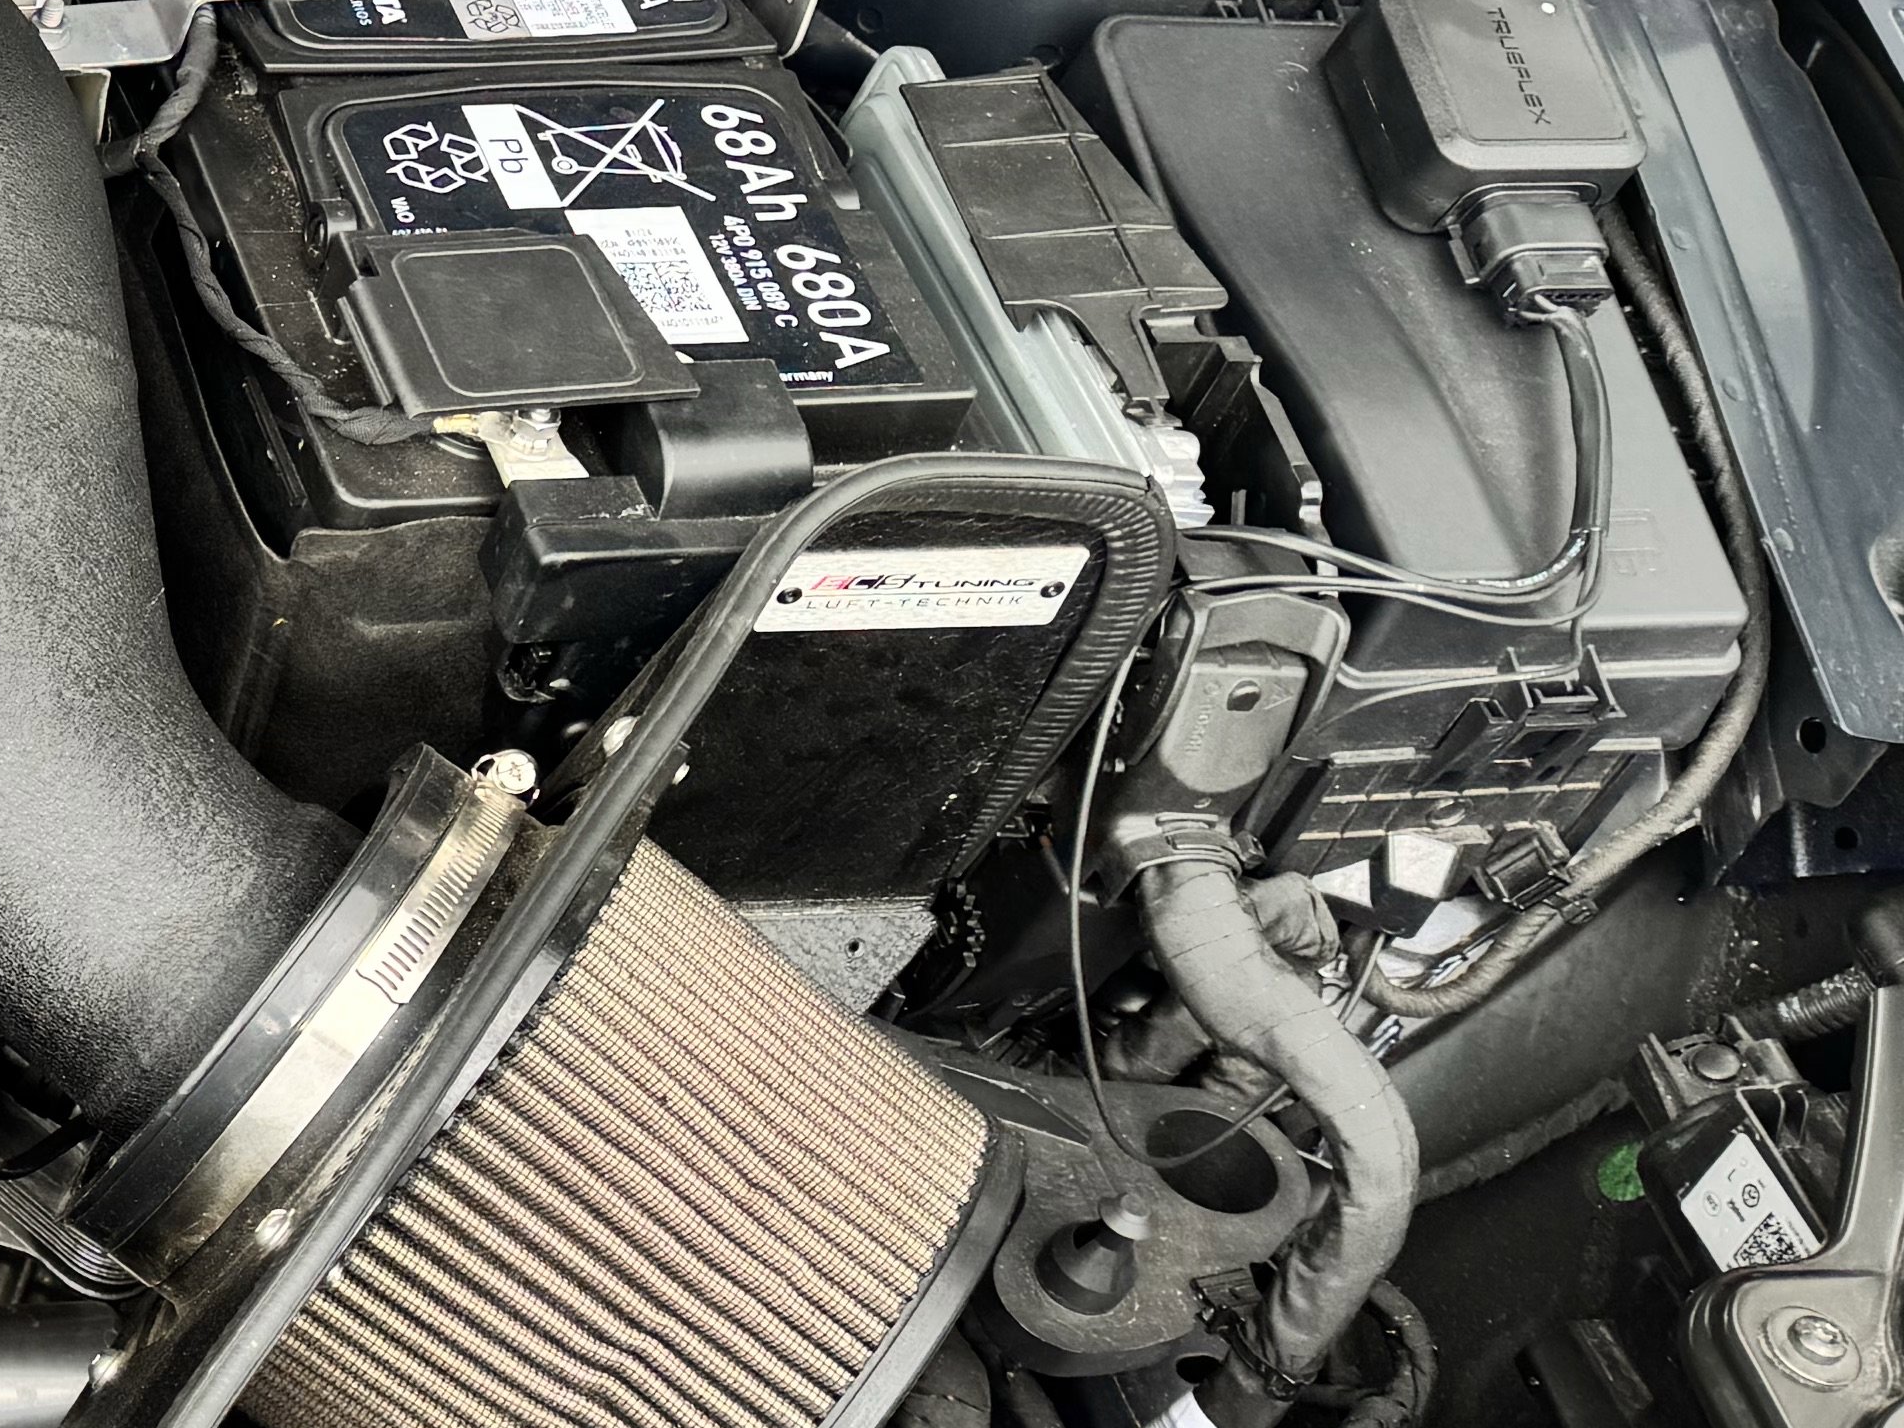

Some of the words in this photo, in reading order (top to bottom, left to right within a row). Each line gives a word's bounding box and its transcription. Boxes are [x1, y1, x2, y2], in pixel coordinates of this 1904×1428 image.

[1488, 7, 1551, 125] TRUEFLEX
[488, 138, 529, 174] Pb
[701, 104, 807, 222] 68Ah
[776, 244, 890, 370] 680A
[723, 213, 756, 246] 4P0
[708, 232, 731, 255] 12V
[737, 287, 763, 312] DIN
[746, 249, 773, 282] 915
[758, 281, 791, 311] 089
[775, 315, 799, 330] C
[777, 370, 834, 384] ermany
[809, 573, 917, 590] ECS
[914, 578, 1042, 588] TUNING
[805, 595, 1024, 610] LUFT-TECHNIK
